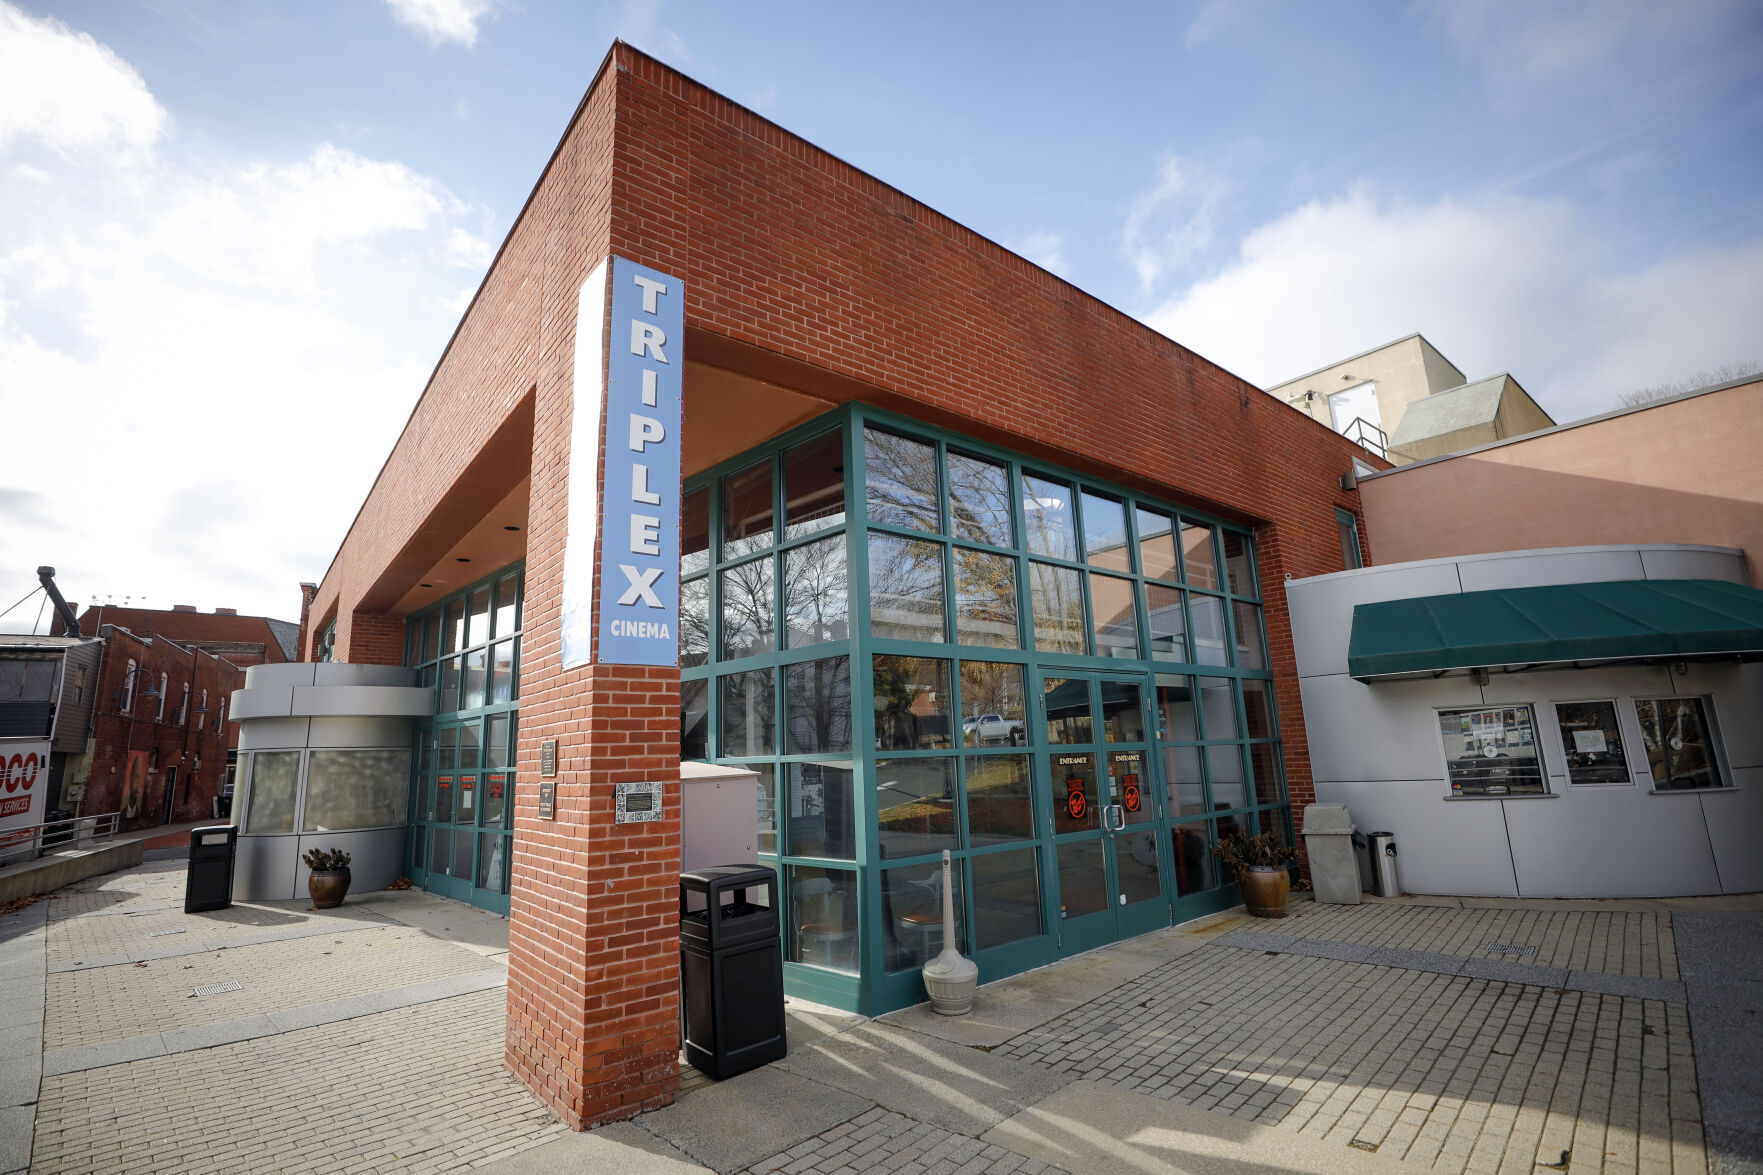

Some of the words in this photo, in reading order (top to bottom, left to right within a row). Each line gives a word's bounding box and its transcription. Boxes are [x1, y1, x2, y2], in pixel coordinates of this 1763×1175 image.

[616, 274, 669, 609] TRIPLEX
[610, 619, 670, 640] CINEMA
[1059, 757, 1088, 765] ENTRANCE
[4, 798, 28, 814] SERVICES
